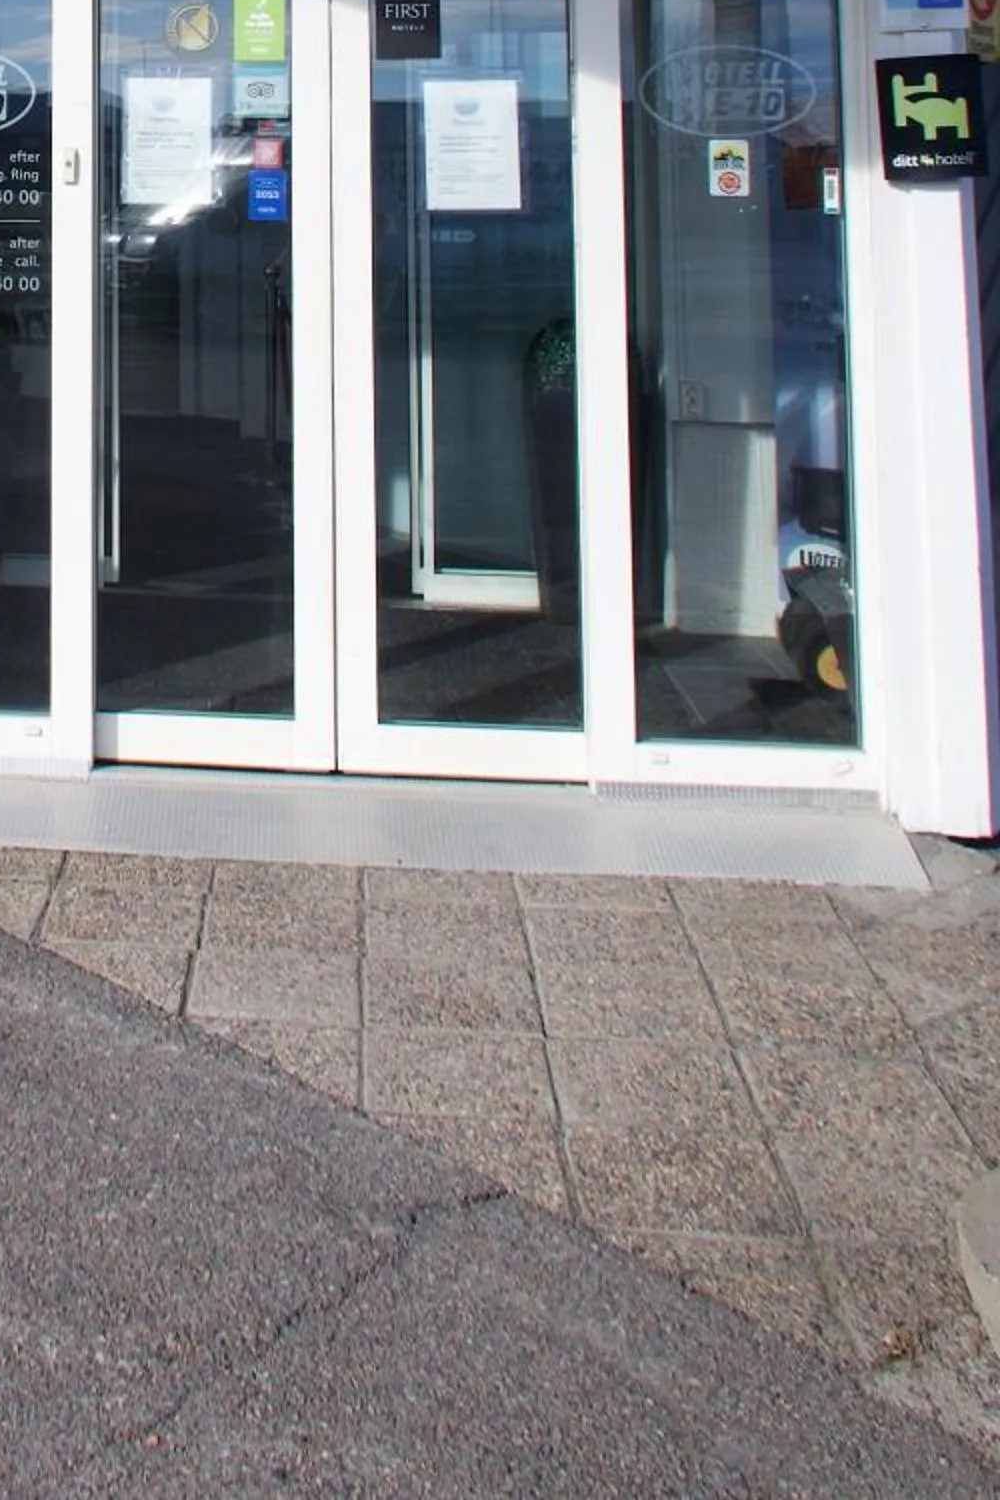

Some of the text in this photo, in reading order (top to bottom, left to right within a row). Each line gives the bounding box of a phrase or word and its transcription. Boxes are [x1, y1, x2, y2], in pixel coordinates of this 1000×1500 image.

[385, 3, 431, 19] FIRST
[9, 150, 40, 162] efter
[892, 153, 919, 167] ditt
[11, 167, 39, 183] Ring
[19, 189, 40, 205] 00
[9, 236, 40, 249] after
[19, 276, 40, 291] 00
